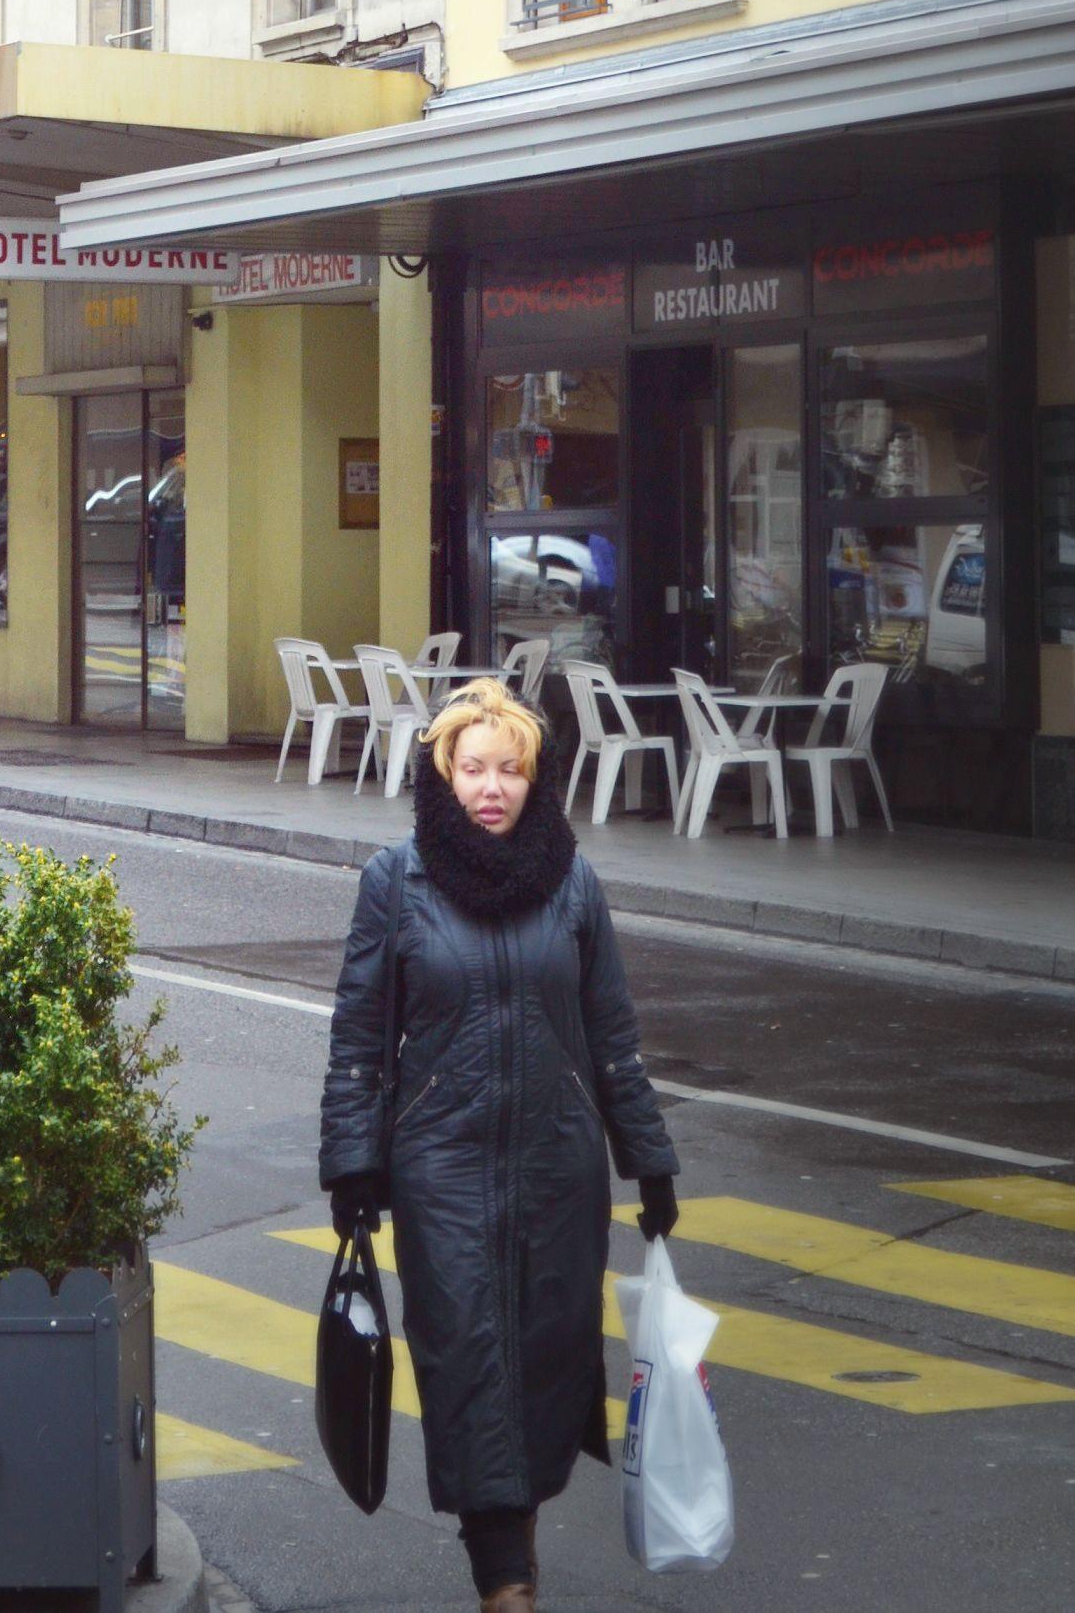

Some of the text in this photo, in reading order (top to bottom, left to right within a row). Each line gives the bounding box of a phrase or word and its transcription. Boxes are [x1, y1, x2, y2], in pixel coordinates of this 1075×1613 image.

[219, 253, 355, 296] TEL MODERNE
[695, 238, 735, 272] BAR
[814, 230, 994, 283] CONCORDE
[482, 271, 625, 319] CONCORDE
[654, 278, 779, 322] RESTAURANT
